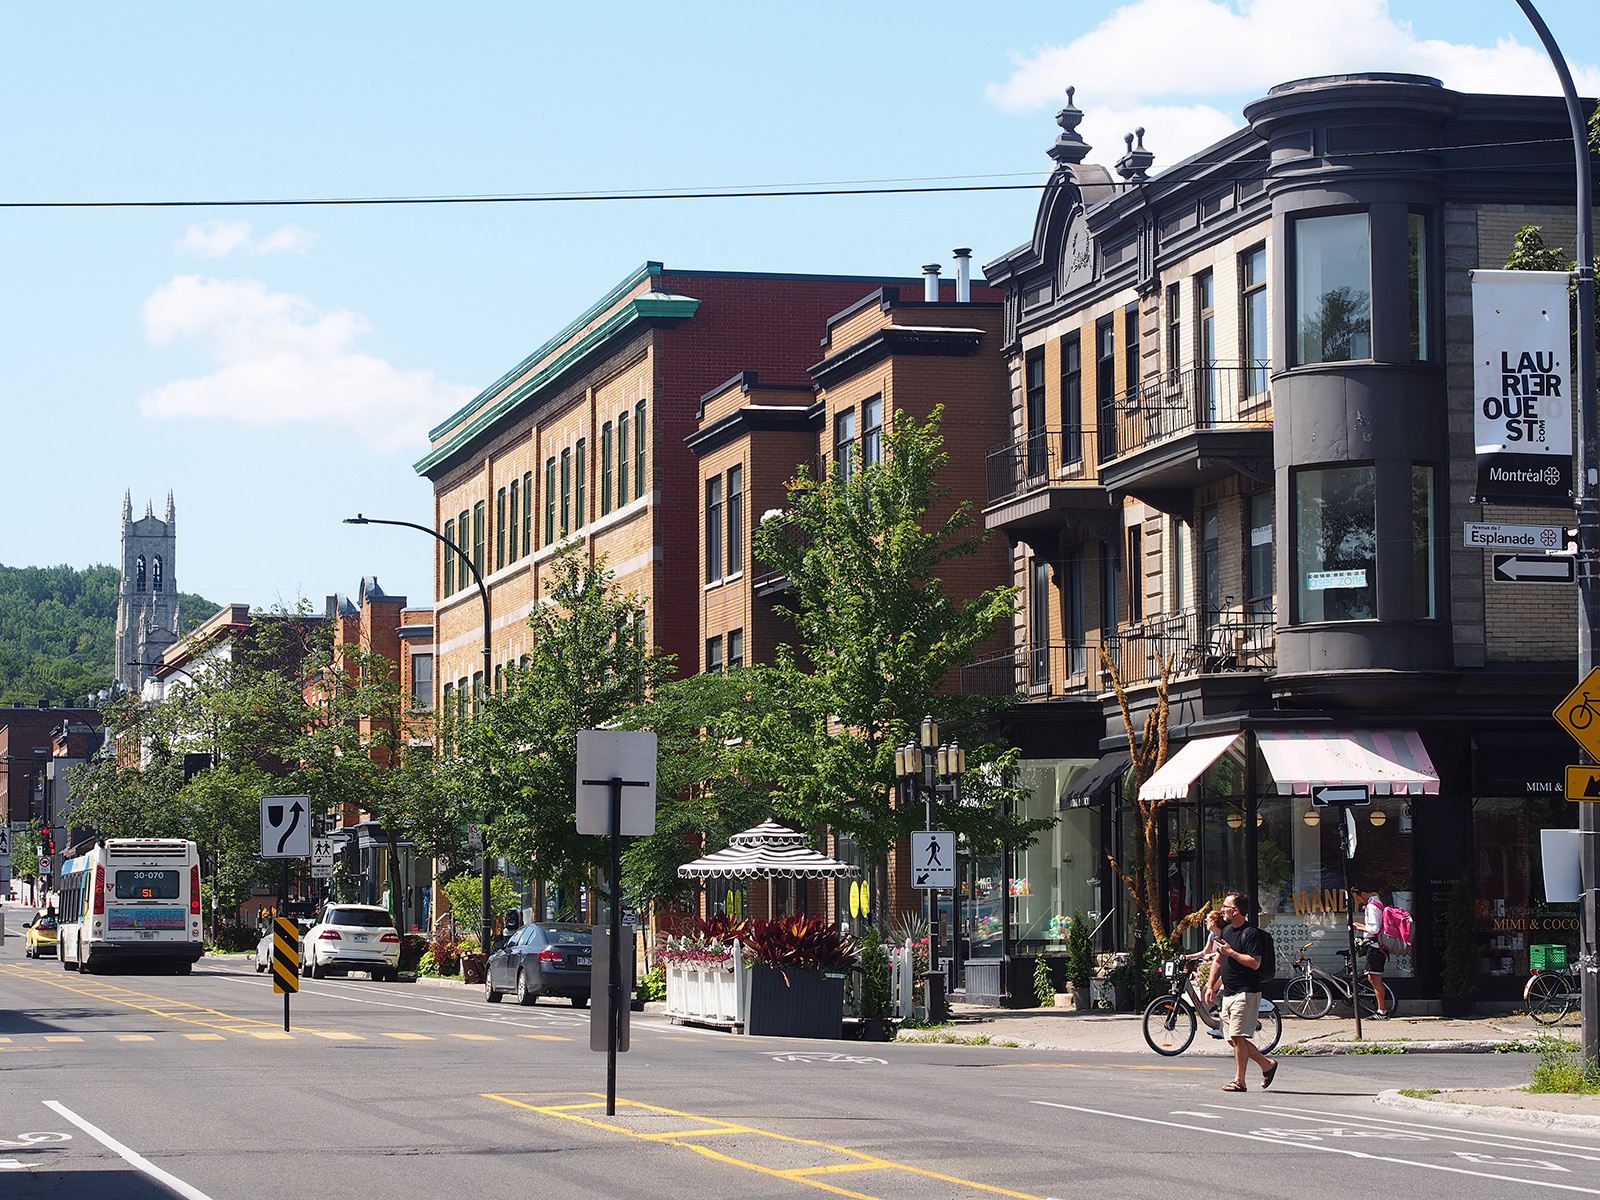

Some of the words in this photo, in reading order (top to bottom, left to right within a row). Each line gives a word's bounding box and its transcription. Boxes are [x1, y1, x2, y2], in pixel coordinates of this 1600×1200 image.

[1501, 351, 1553, 373] LAU
[1482, 396, 1538, 420] OUE
[1505, 418, 1538, 442] ST
[1489, 467, 1543, 482] Montréal
[1471, 530, 1535, 546] Esplanade
[1526, 782, 1552, 792] MIMI
[1554, 782, 1563, 792] &
[133, 871, 164, 879] 30-070
[142, 888, 152, 897] 51
[1493, 918, 1526, 930] MIMI
[1529, 918, 1540, 930] &
[1542, 918, 1580, 930] COCO
